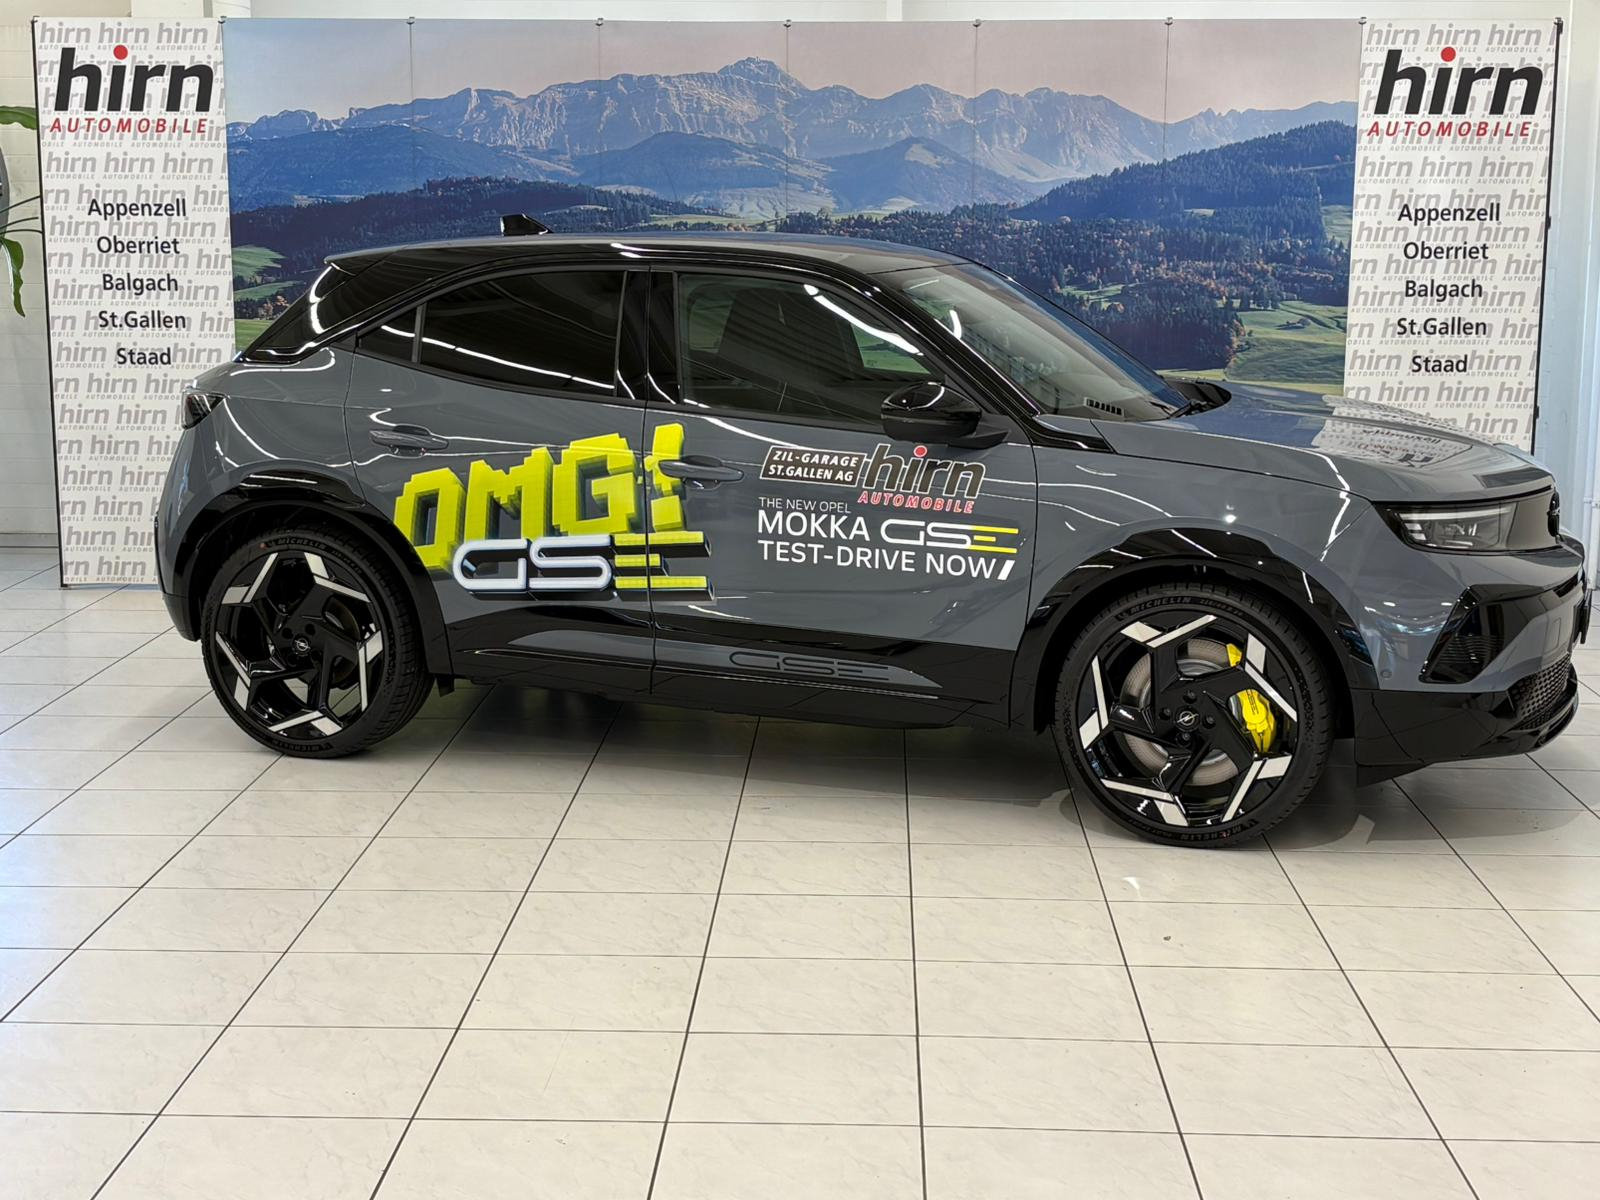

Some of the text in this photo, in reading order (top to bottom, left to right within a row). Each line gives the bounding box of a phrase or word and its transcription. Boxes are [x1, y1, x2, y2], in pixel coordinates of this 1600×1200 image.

[41, 22, 208, 44] hirn hirn hirn
[1367, 23, 1541, 45] hirn hirn hirn
[54, 45, 214, 112] hirn
[1374, 46, 1543, 115] hirn
[50, 117, 208, 134] AUTOMOBILE
[1367, 121, 1532, 137] AUTOMOBILE
[47, 152, 213, 174] hirn hirn hirn
[1359, 156, 1533, 178] hirn hirn hirn
[45, 184, 70, 204] rn
[78, 184, 128, 205] hirn
[194, 185, 229, 206] hir
[1355, 188, 1381, 210] rn
[1388, 189, 1441, 210] hirn
[1509, 189, 1546, 210] hir
[88, 198, 187, 220] Appenzell
[1397, 203, 1501, 226] Appenzell
[50, 216, 216, 238] hirn hirn hirn
[1356, 221, 1529, 243] hirn hirn hirn
[97, 235, 180, 254] Oberriet
[1403, 241, 1489, 260] Oberriet
[48, 247, 73, 267] rn
[81, 248, 131, 268] hirn
[197, 249, 231, 270] hir
[1352, 253, 1378, 275] rn
[1385, 253, 1438, 275] hirn
[1505, 254, 1542, 275] hir
[53, 279, 103, 299] hirn
[102, 273, 178, 295] Balgach
[1404, 279, 1483, 302] Balgach
[1353, 286, 1406, 307] hirn
[51, 310, 76, 330] rn
[200, 312, 234, 332] hir
[98, 310, 186, 329] St.Gallen
[1349, 317, 1375, 338] rn
[1501, 318, 1538, 339] hir
[1396, 317, 1487, 336] St.Gallen
[56, 342, 106, 362] hirn
[172, 343, 221, 363] hirn
[116, 347, 172, 365] Staad
[1350, 349, 1402, 370] hirn
[1469, 350, 1521, 371] hirn
[1411, 355, 1468, 373] Staad
[54, 372, 79, 392] rn
[87, 373, 137, 393] hirn
[1345, 381, 1534, 403] rn hirn hirn hir
[60, 404, 167, 424] hirn hirn
[1465, 413, 1518, 434] hirn
[57, 434, 140, 454] rn hirn
[772, 450, 859, 468] ZIL-GARAGE
[63, 465, 112, 484] hirn
[768, 465, 854, 482] ST.GALLEN AG
[863, 443, 986, 498] hirn
[60, 495, 143, 515] rn hirn
[758, 496, 851, 514] THE NEW OPEL
[857, 490, 975, 514] AUTOMOBILE
[66, 526, 115, 545] hirn
[757, 509, 1019, 553] MOKKA GSE
[63, 555, 146, 575] rn hirn
[453, 531, 713, 599] GSE
[757, 539, 916, 572] TEST-DRIVE
[1129, 596, 1192, 614] MICHELIN
[730, 651, 889, 681] GSE
